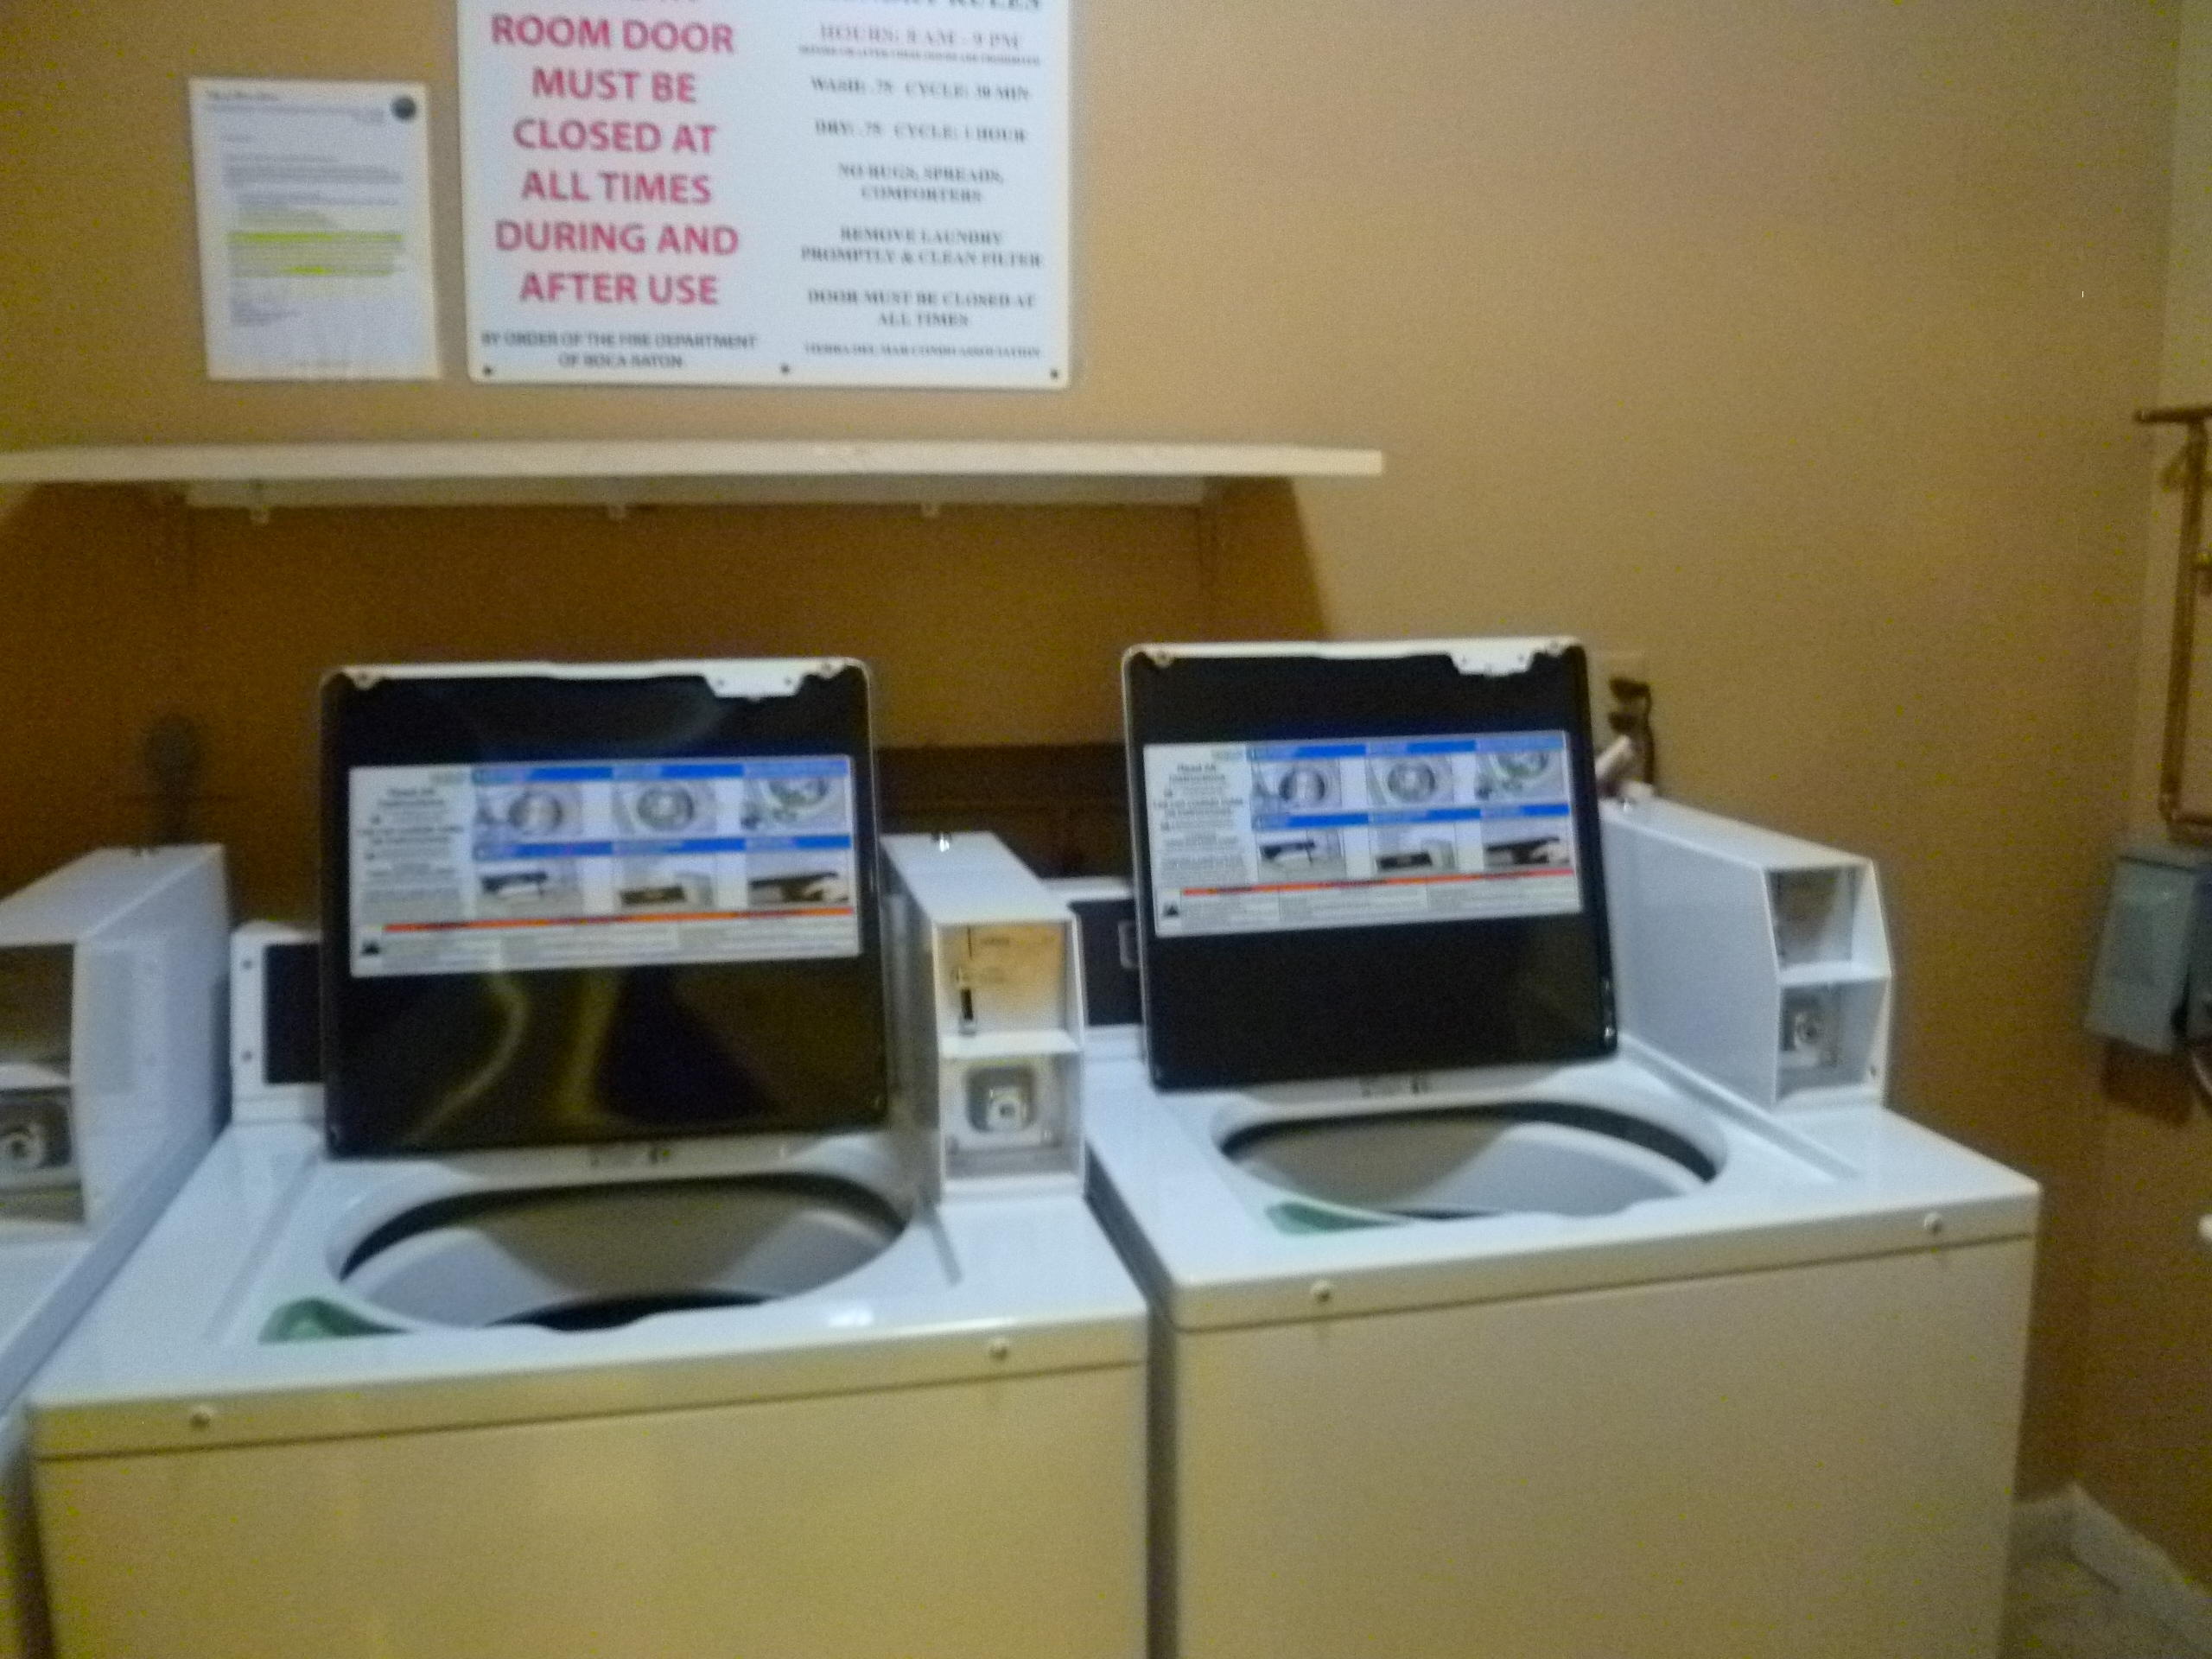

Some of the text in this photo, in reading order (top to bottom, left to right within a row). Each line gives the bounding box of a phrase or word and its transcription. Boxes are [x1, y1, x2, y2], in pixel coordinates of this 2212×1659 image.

[491, 13, 734, 54] ROOM DOOR
[925, 29, 954, 45] AM
[989, 31, 1020, 49] PM
[532, 67, 696, 104] MUST BE
[513, 118, 717, 154] CLOSED AT
[976, 125, 1026, 142] HOUR
[521, 170, 711, 205] ALL TIMES
[494, 219, 740, 256] DURING AND
[841, 226, 1002, 245] REMOVE LAUNDRY
[801, 246, 895, 264] PROMPTLY
[918, 250, 976, 266] CLEAN
[982, 251, 1042, 268] FILTER
[519, 271, 719, 306] AFTER USE
[807, 289, 1036, 308] DOOR MUST BE CLOSED AT
[878, 311, 969, 327] ALL TIMES
[481, 332, 756, 348] BY ORDER OF THE FIRE DEPARTMENT
[559, 353, 578, 367] OF
